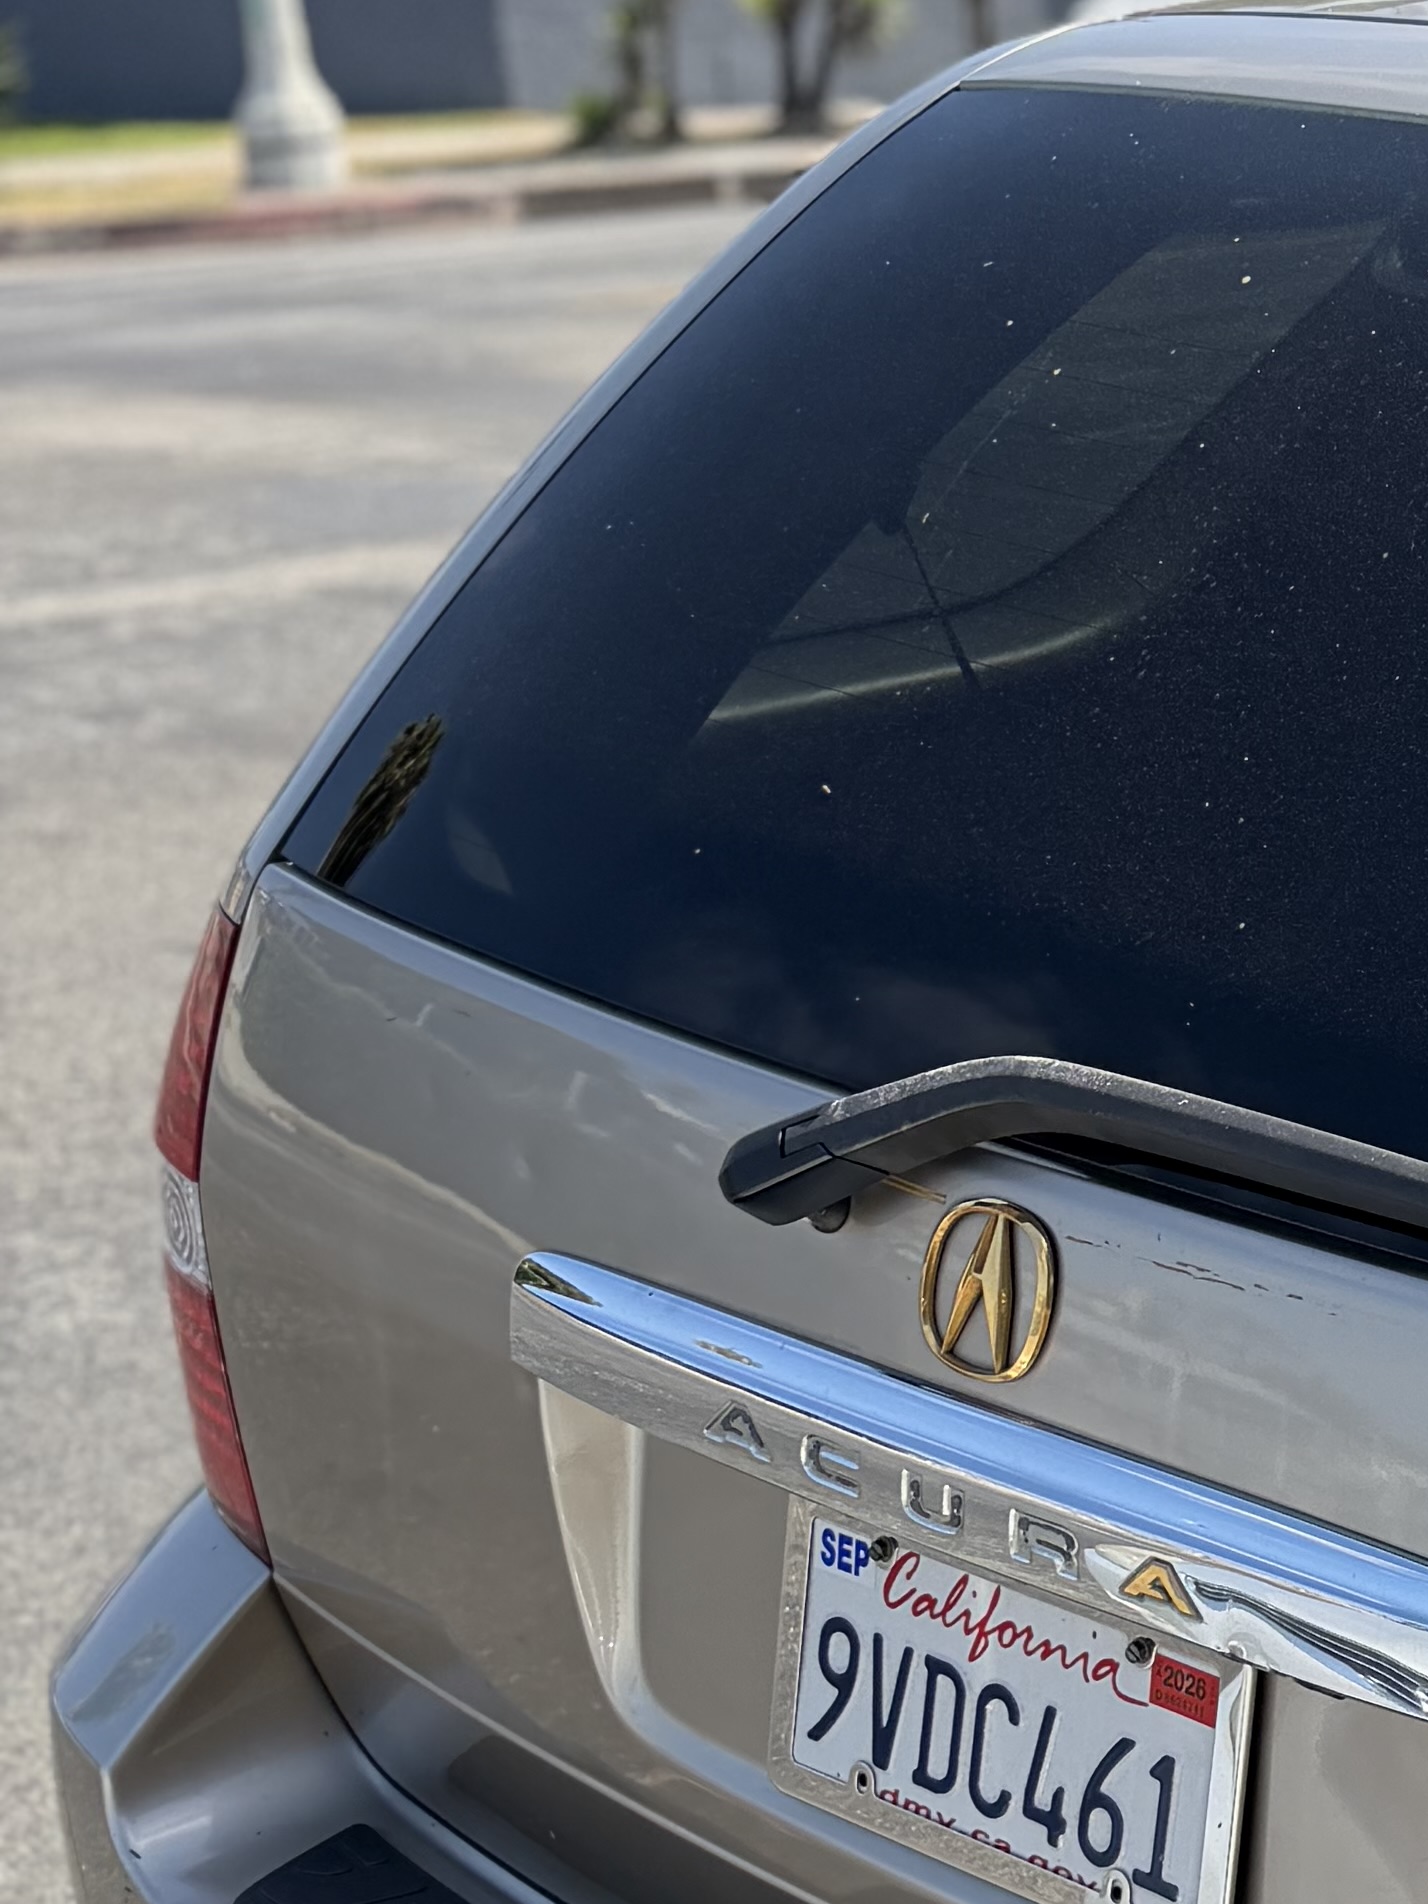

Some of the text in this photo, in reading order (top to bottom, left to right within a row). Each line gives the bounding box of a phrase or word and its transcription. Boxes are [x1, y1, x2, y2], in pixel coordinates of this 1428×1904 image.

[703, 1400, 1206, 1626] ACURA
[819, 1527, 870, 1578] SEP
[883, 1550, 1150, 1708] California
[1161, 1664, 1208, 1701] 2026
[807, 1616, 1180, 1904] 9VDC461
